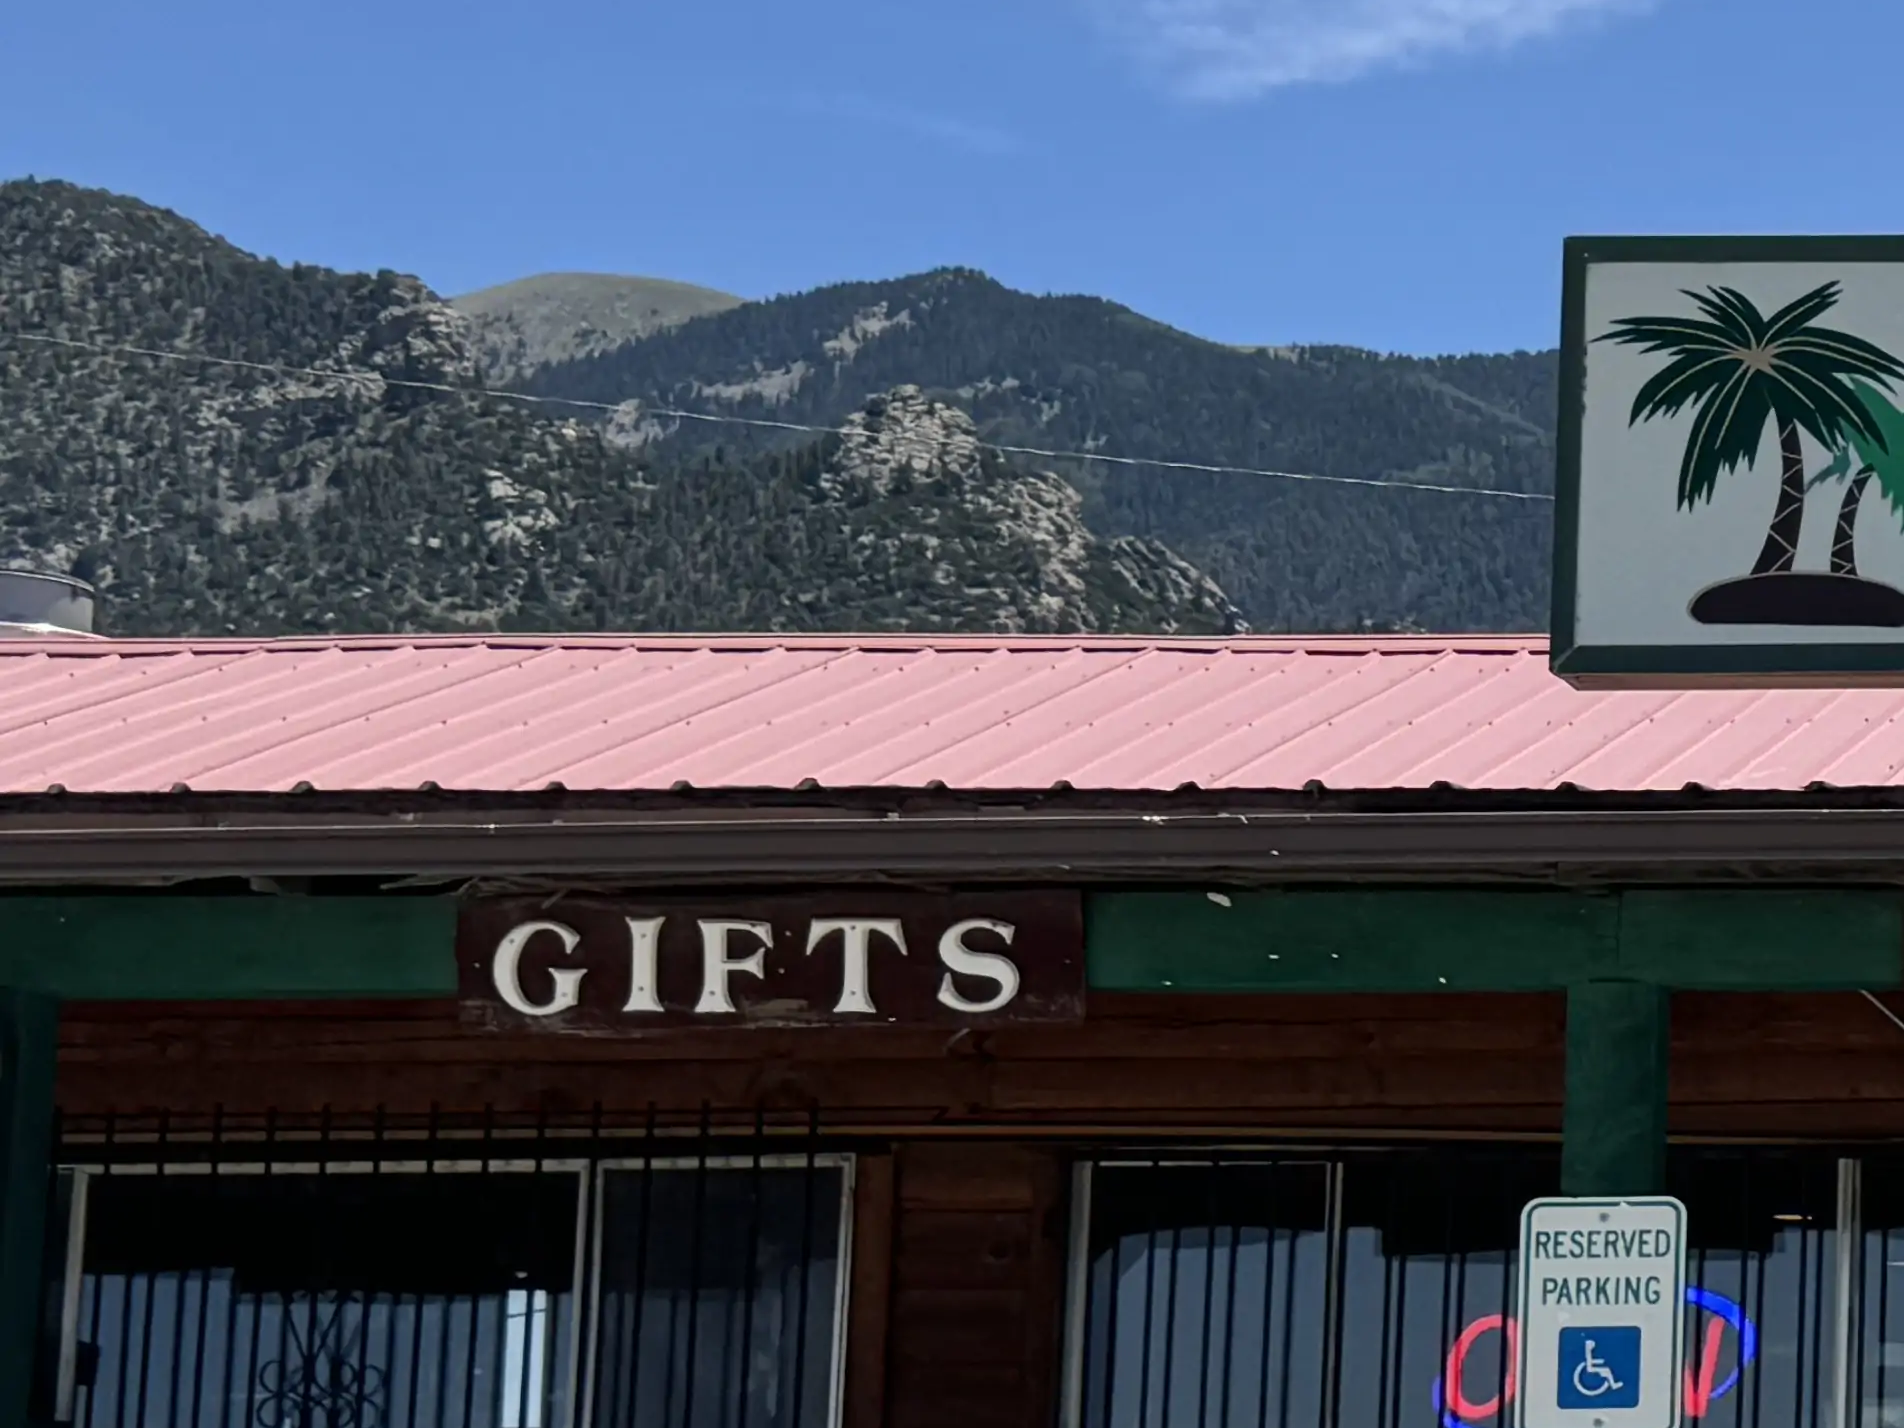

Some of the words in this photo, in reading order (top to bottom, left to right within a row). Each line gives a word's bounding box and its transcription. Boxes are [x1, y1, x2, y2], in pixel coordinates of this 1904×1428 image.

[493, 917, 1020, 1015] GIFTS
[1535, 1229, 1671, 1259] RESERVED
[1542, 1276, 1661, 1305] PARKING
